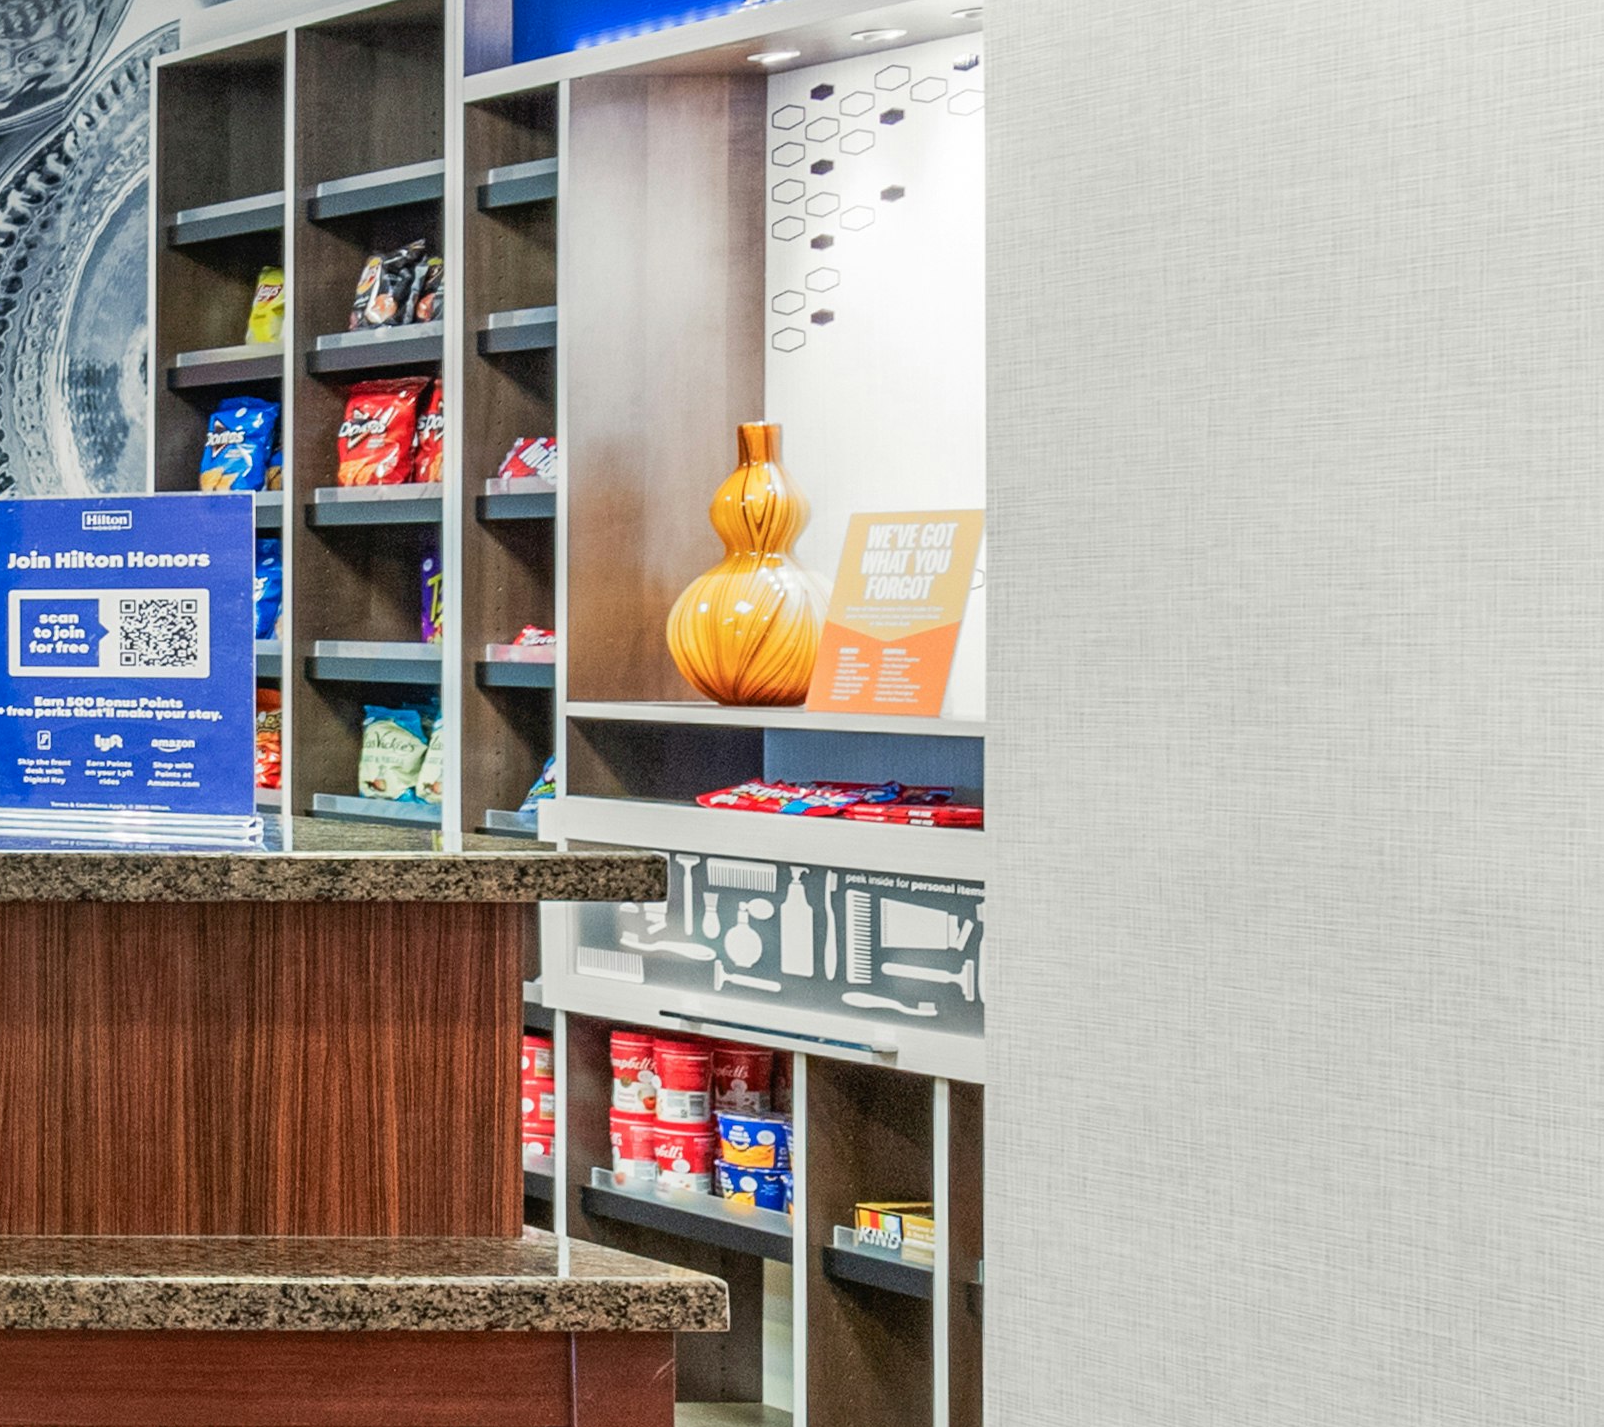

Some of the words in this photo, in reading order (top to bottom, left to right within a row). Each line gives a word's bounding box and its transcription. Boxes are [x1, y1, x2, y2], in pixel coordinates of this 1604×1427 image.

[86, 514, 128, 525] Hilton
[866, 524, 921, 548] WE'VE
[921, 523, 958, 547] GOT
[7, 550, 51, 569] Join
[55, 549, 124, 569] Hilton
[127, 551, 211, 568] Honors
[861, 549, 914, 575] WHAT
[914, 549, 952, 574] YOU
[863, 575, 934, 601] FORGOT
[39, 614, 79, 624] scan
[33, 626, 52, 639] to
[53, 624, 85, 641] join
[29, 640, 54, 653] for
[55, 640, 90, 653] free
[34, 696, 65, 707] Earn
[66, 697, 94, 707] 500
[96, 697, 137, 708] Bonus
[139, 697, 183, 709] Points
[6, 705, 33, 717] free
[35, 707, 72, 719] perks
[74, 707, 115, 718] that'll
[116, 707, 154, 718] make
[155, 710, 187, 721] your
[188, 709, 223, 721] stay.
[94, 734, 123, 752] lyft
[151, 738, 196, 750] amazon
[17, 758, 35, 767] Skip
[36, 758, 50, 766] the
[106, 760, 132, 768] Points
[152, 761, 174, 771] Shop
[175, 762, 194, 770] with
[23, 776, 50, 785] Digital
[50, 777, 66, 785] Key
[155, 770, 182, 779] Points
[147, 779, 200, 788] Amazon.com
[845, 874, 867, 884] peek
[868, 875, 894, 887] inside
[896, 877, 909, 889] for
[911, 881, 955, 894] personal
[859, 1226, 901, 1250] KIND
